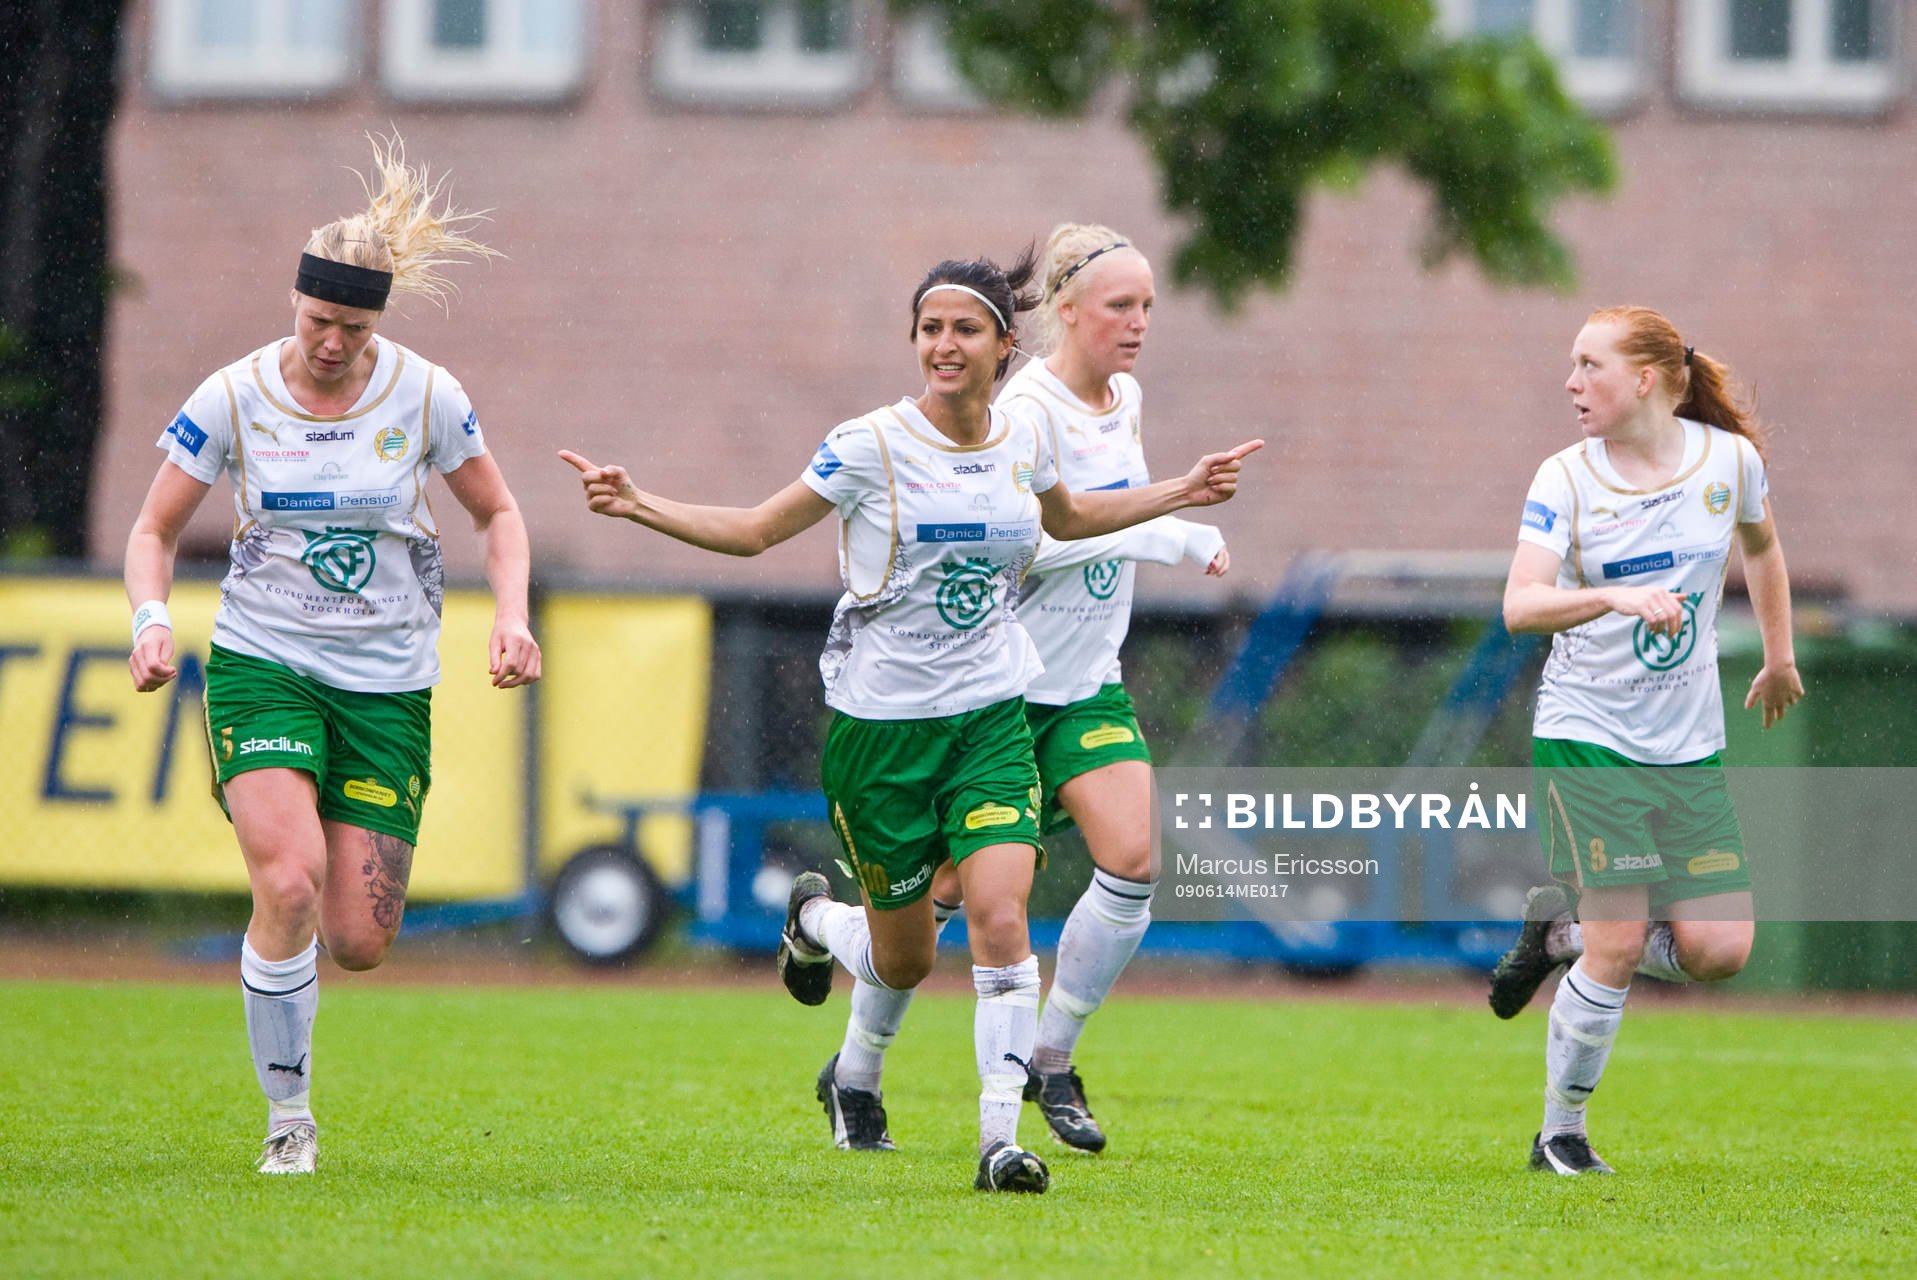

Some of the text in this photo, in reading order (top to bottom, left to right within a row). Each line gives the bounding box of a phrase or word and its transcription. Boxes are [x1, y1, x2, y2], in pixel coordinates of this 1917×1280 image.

[305, 430, 355, 442] stadium
[952, 463, 996, 475] stadium
[277, 494, 397, 507] Danica Pension
[935, 527, 1032, 540] Danica Pension
[1619, 557, 1672, 575] Danica
[220, 727, 233, 760] 5
[240, 737, 312, 756] stadium
[1590, 837, 1607, 873] 8
